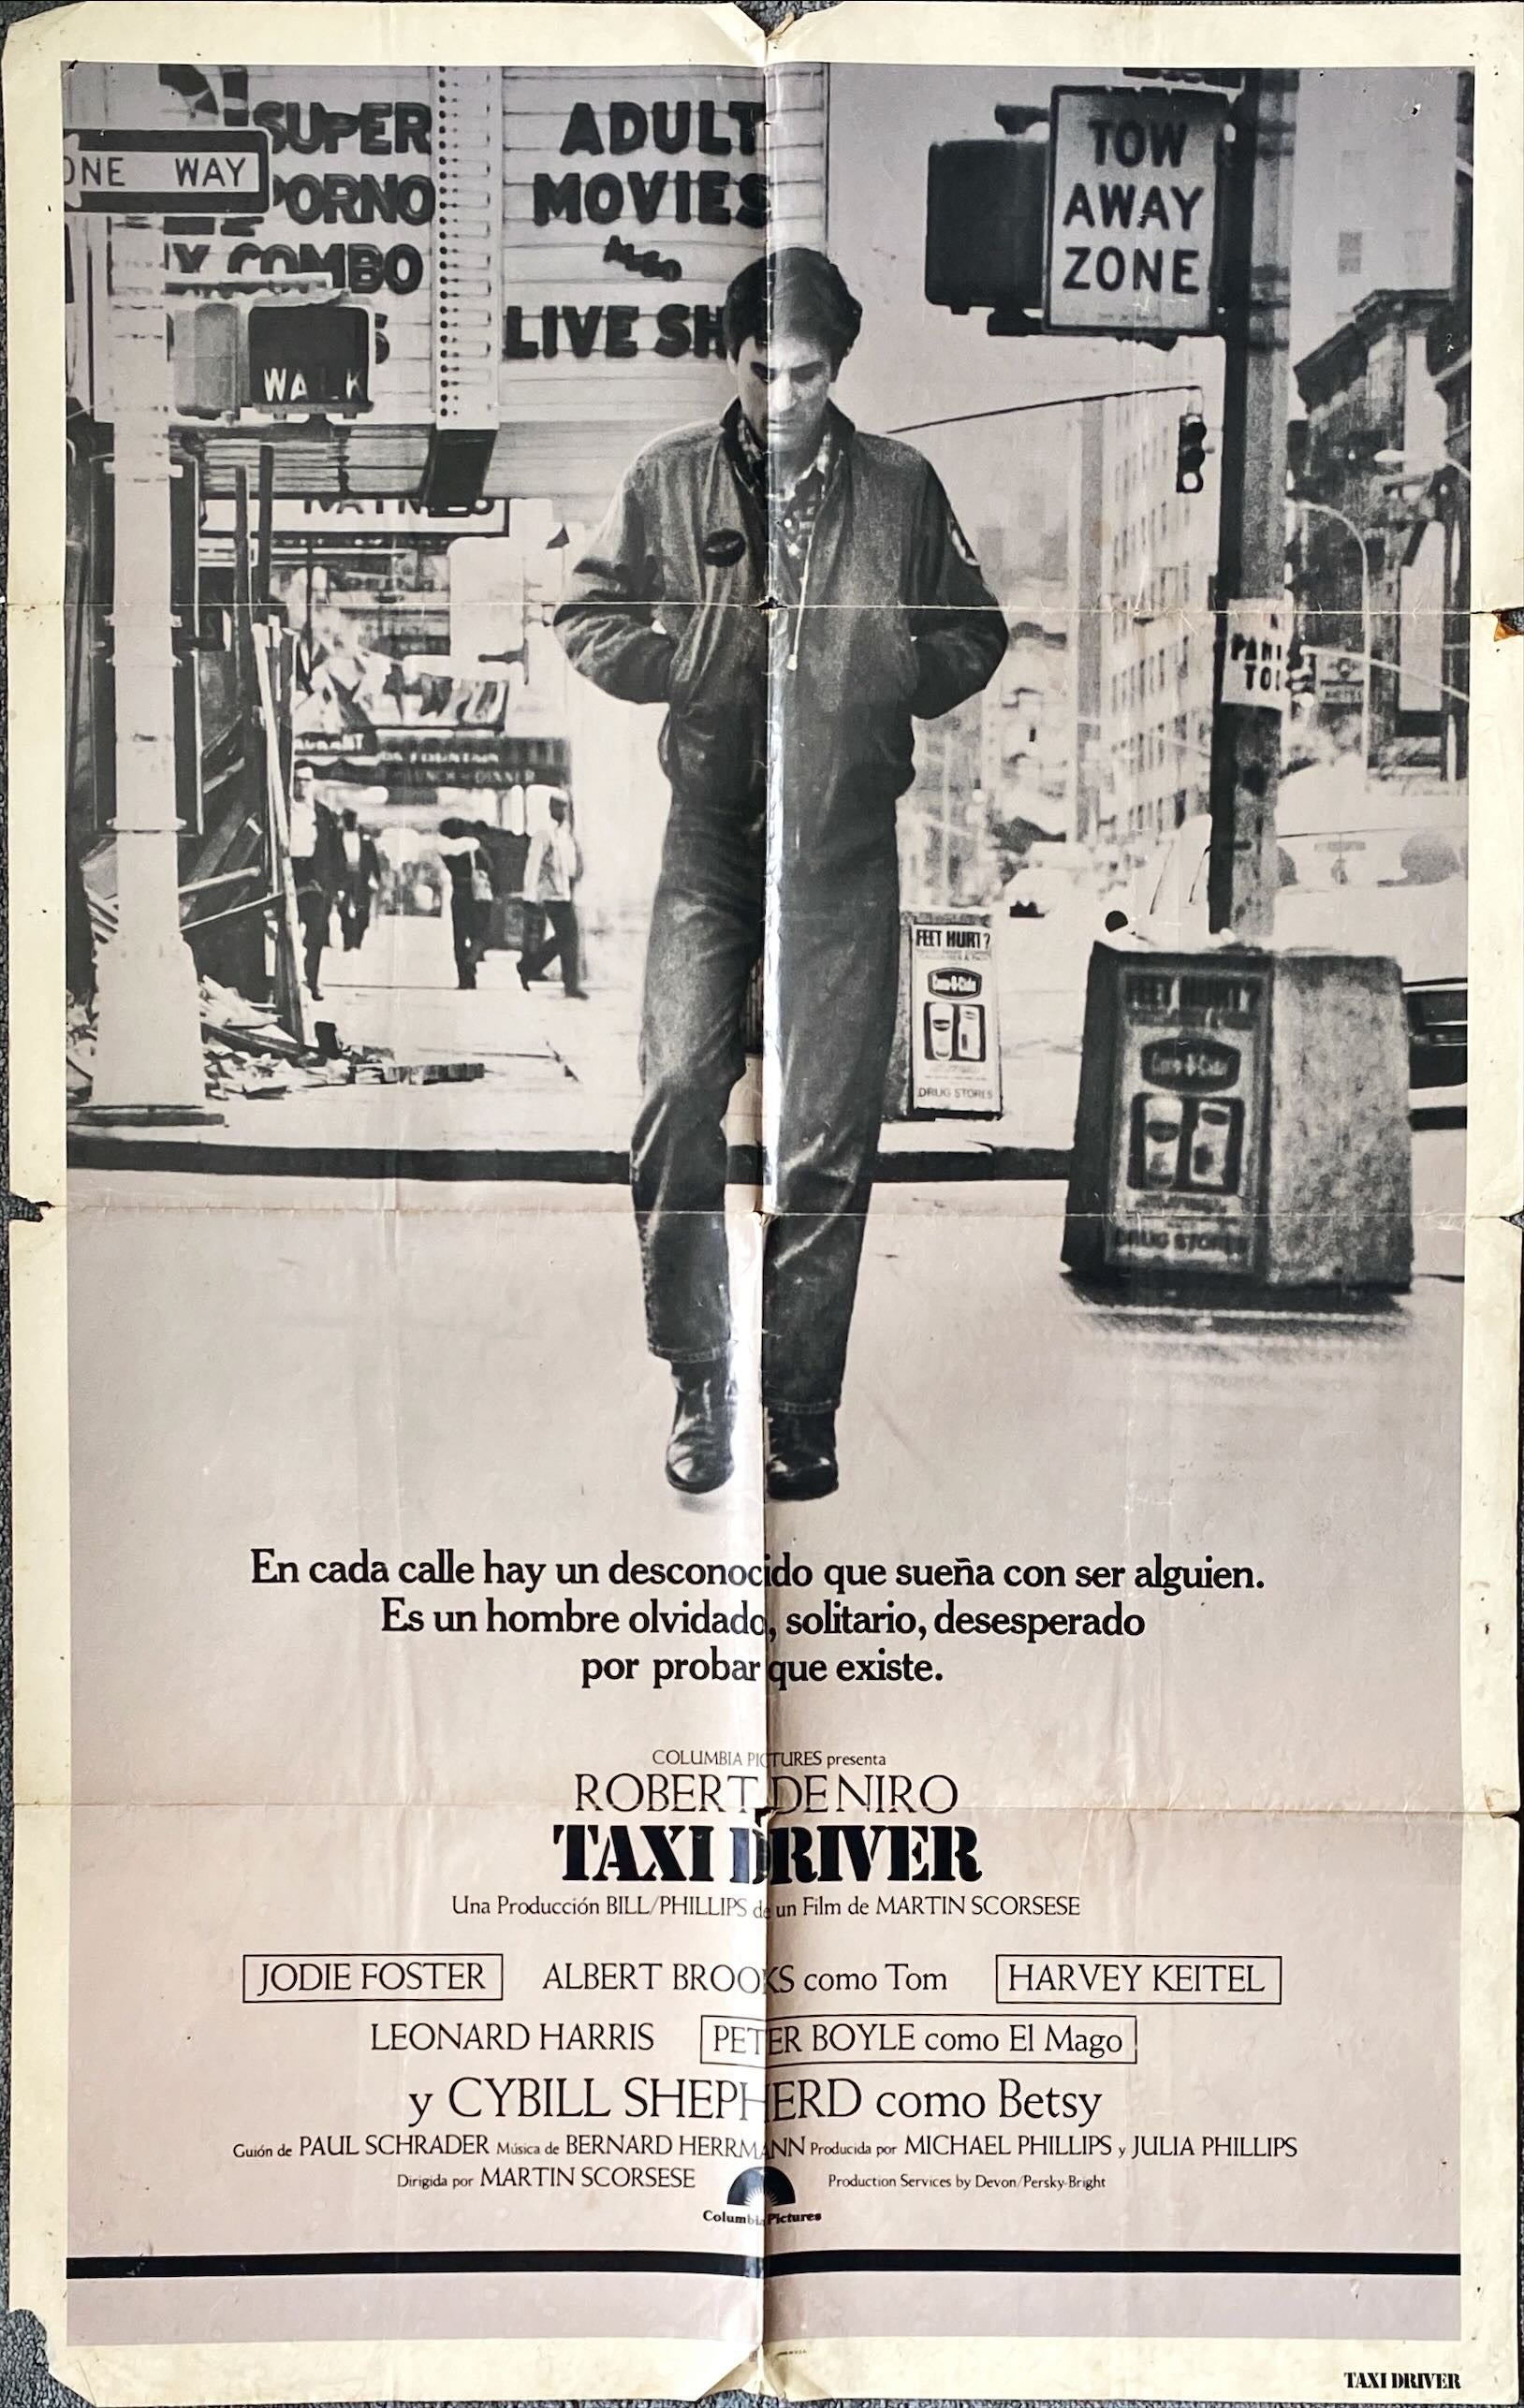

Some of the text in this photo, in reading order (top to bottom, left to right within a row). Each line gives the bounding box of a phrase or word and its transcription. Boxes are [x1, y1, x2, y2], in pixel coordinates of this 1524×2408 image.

[253, 100, 432, 155] SUPER
[560, 100, 768, 156] ADULT
[1087, 119, 1188, 168] TOW
[175, 156, 246, 187] WAY
[533, 170, 771, 228] MOVIES
[1062, 182, 1203, 231] AWAY
[1062, 246, 1200, 295] ZONE
[506, 305, 639, 358] LIVE
[916, 928, 942, 947] FEET
[917, 1087, 951, 1099] DRUG
[250, 1548, 1264, 1596] En cada calle hay un desconocido que sueña con ser alguien.
[381, 1597, 1145, 1643] Es un hombre olvidado, solitario, desesperado
[581, 1645, 943, 1690] por probar que existe.
[652, 1749, 886, 1769] COLUMBIA PICTURES presenta
[575, 1773, 958, 1815] ROBERT DE NIRO
[553, 1825, 983, 1884] TAXI DRIVER
[453, 1895, 1080, 1919] Una Producción BILL/PHILLIPS de un Film de MARTIN SCORSESE
[257, 1962, 486, 1996] JODIE FOSTER
[542, 1963, 947, 1994] ALBERT BROOKS como Tom
[1009, 1963, 1266, 1992] HARVEY KEITEL
[371, 2022, 653, 2050] LEONARD HARRIS
[714, 2023, 1123, 2059] PETER BOYLE como El Mago
[408, 2077, 1103, 2128] y CYBILL SHEPHERD como Betsy
[233, 2134, 1297, 2160] Guión de PAUL SCHRADER Música de BERNARD HERRMANN Producida por MICHAEL PHILLIPS y JULIA PHILLIPS
[397, 2167, 696, 2190] Dirigida por MARTIN SCORSESE
[828, 2174, 896, 2187] Production
[901, 2173, 951, 2187] Services
[956, 2174, 971, 2191] by
[767, 2212, 821, 2225] Pictures
[1344, 2372, 1461, 2389] TAXI DRIVER
